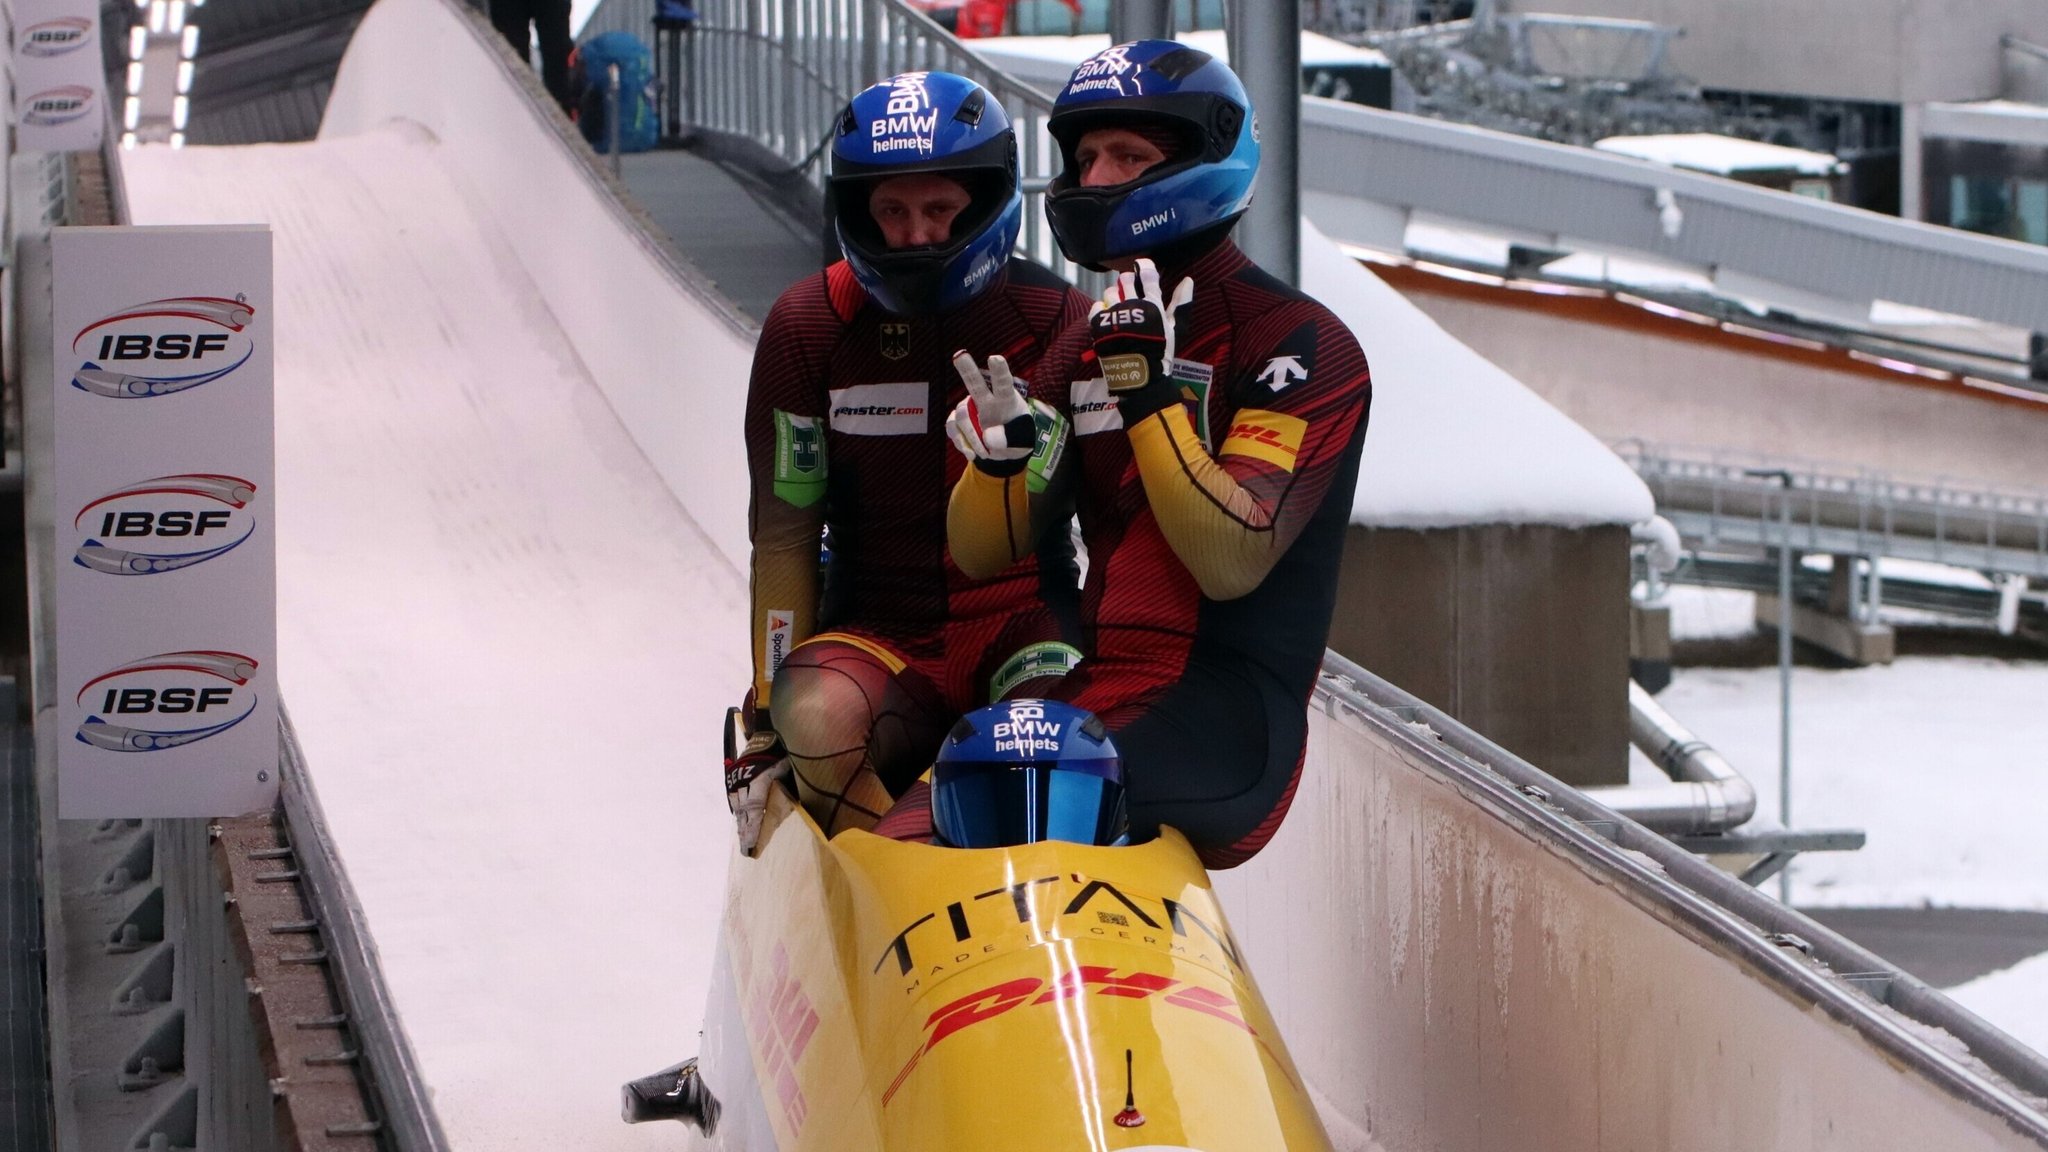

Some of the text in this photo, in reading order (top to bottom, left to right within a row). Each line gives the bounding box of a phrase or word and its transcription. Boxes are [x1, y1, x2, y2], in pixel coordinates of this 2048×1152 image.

[871, 115, 936, 138] BMW
[873, 136, 933, 153] helmets
[1131, 208, 1168, 236] BMW
[963, 262, 991, 288] BMW
[1100, 308, 1145, 327] SEIZ
[98, 334, 229, 360] IBSF
[834, 405, 924, 418] fenster.com
[101, 511, 231, 537] IBSF
[102, 688, 233, 714] IBSF
[994, 721, 1061, 738] BMW
[996, 738, 1059, 752] helmets
[727, 765, 755, 789] SEIZ
[873, 875, 1246, 977] TITAN
[905, 943, 996, 996] MADE
[922, 965, 1259, 1057] DHL
